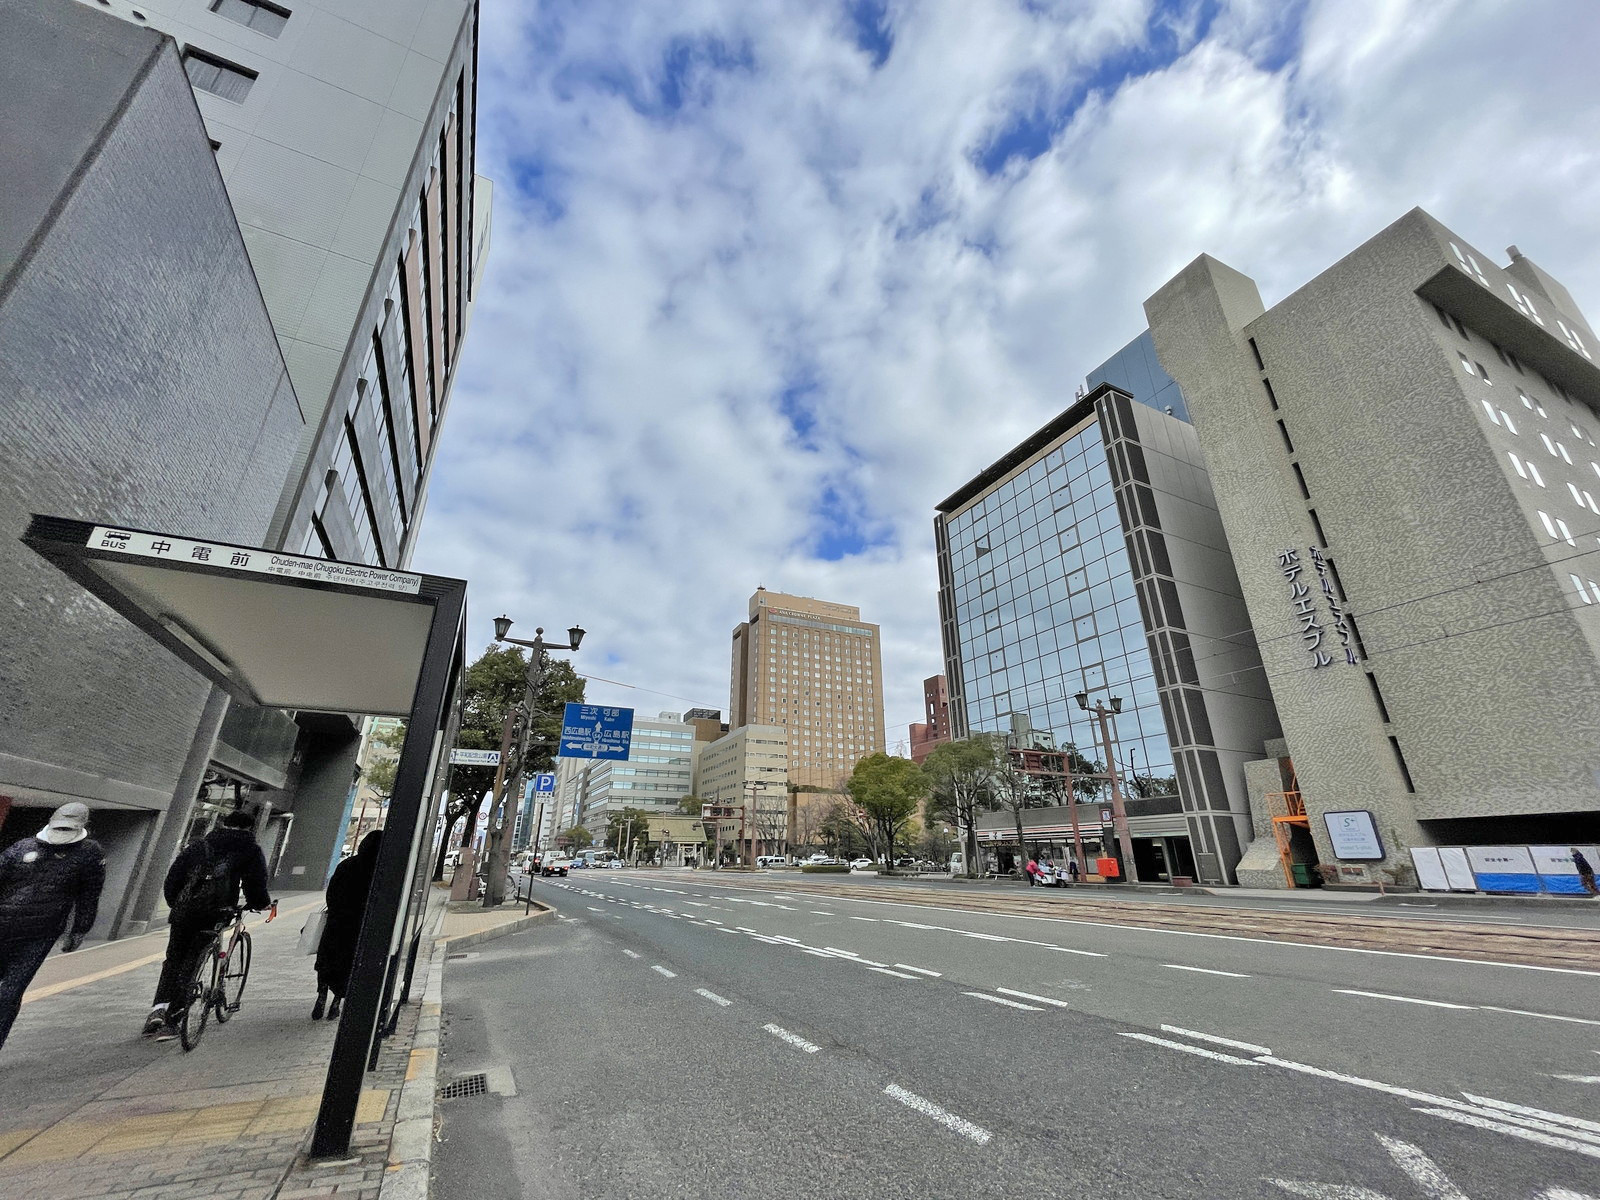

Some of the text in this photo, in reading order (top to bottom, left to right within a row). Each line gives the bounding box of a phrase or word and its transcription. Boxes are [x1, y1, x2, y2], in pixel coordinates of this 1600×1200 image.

[101, 540, 126, 550] BUS
[151, 540, 251, 567] 中電前
[271, 556, 418, 587] Chuden-mae (Chugoku Electric Power Company)
[1279, 549, 1333, 668] ホテルエスプル
[580, 706, 620, 717] 三次 可部
[564, 726, 592, 736] 西広島駅
[604, 730, 629, 739] 広島駅
[540, 776, 551, 790] P
